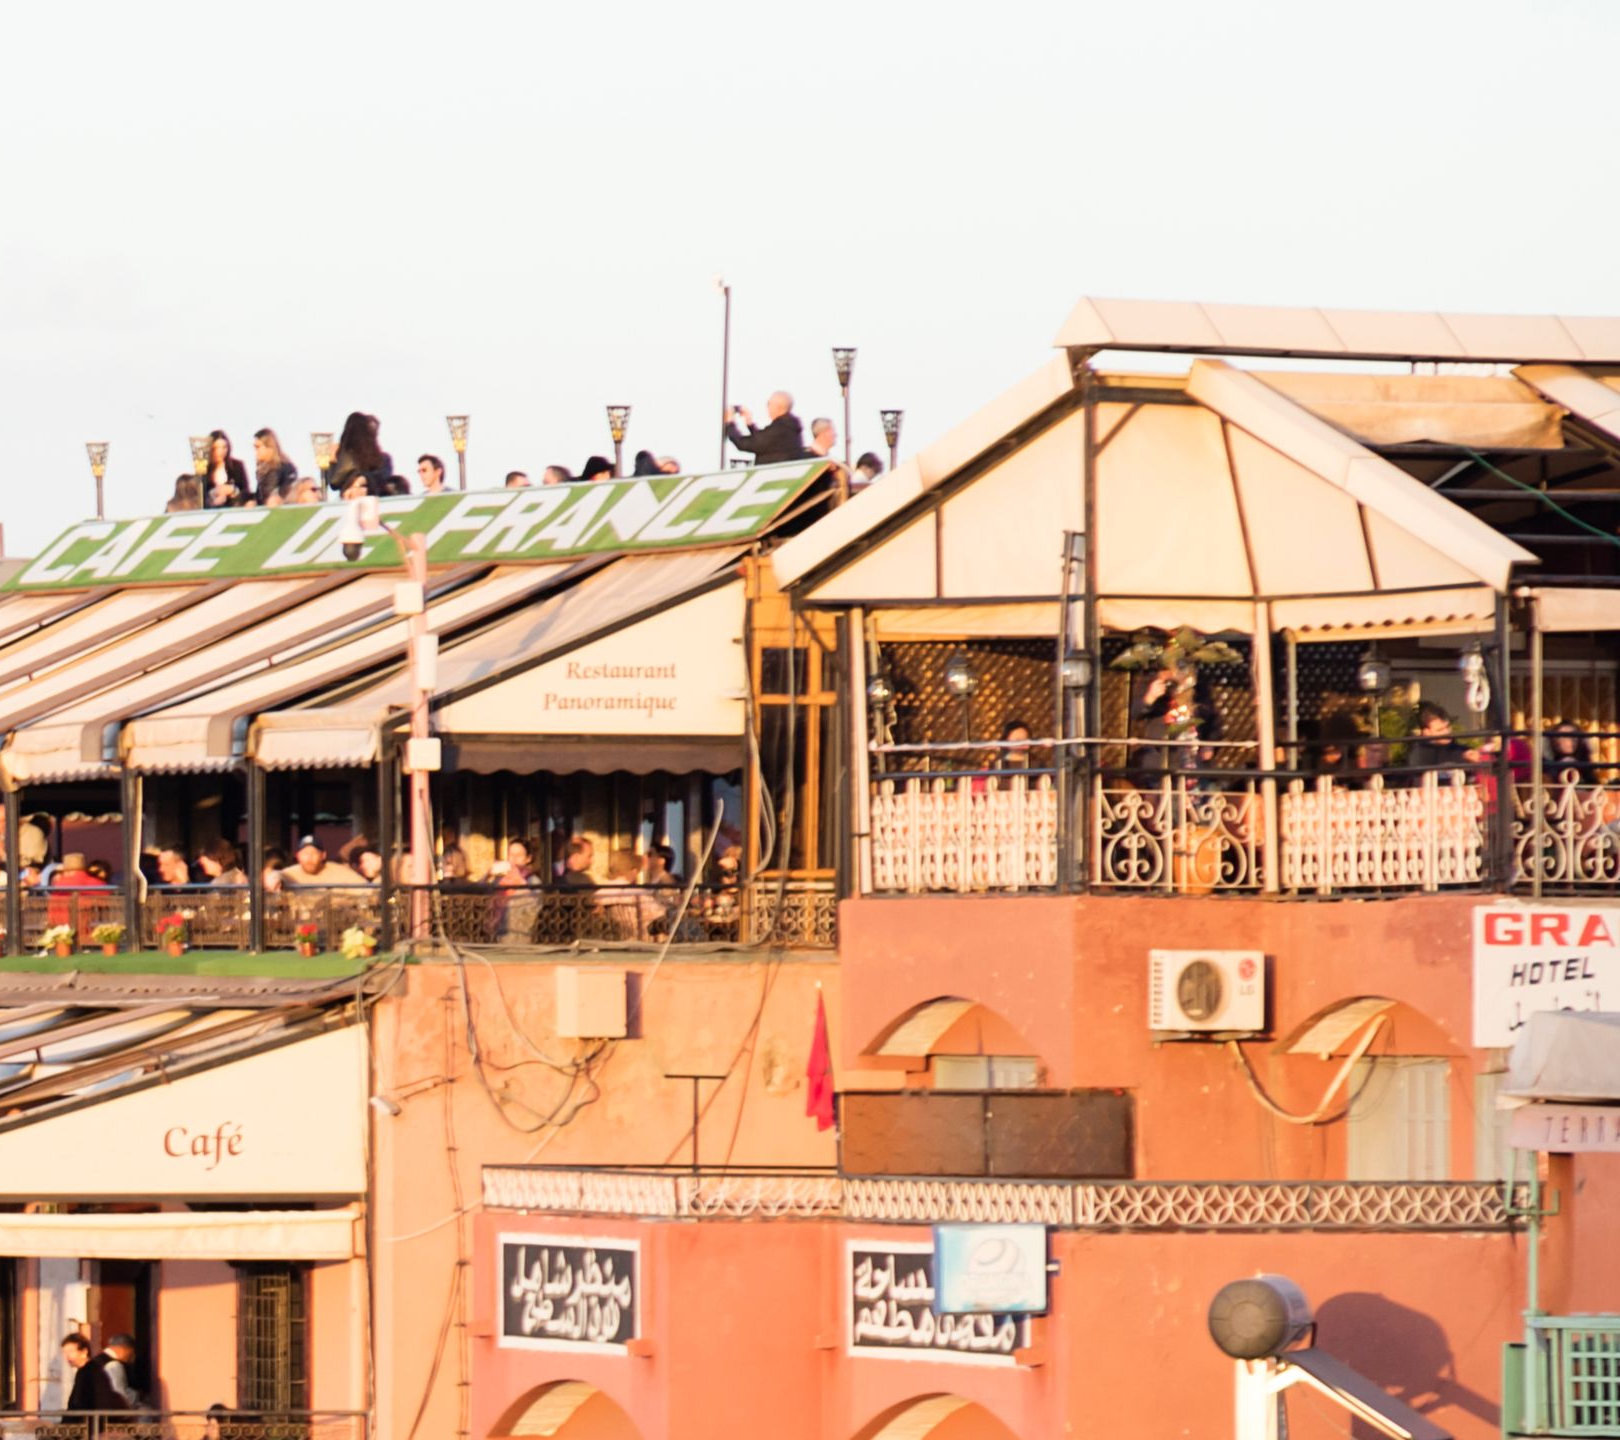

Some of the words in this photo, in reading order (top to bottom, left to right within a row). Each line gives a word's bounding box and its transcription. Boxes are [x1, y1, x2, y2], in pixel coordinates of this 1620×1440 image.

[20, 510, 268, 584] CAFE
[425, 465, 810, 556] FRANCE
[566, 662, 677, 679] Restaurant
[542, 693, 677, 718] Panoramique
[1509, 956, 1596, 988] HOTEL
[163, 1120, 245, 1171] Café
